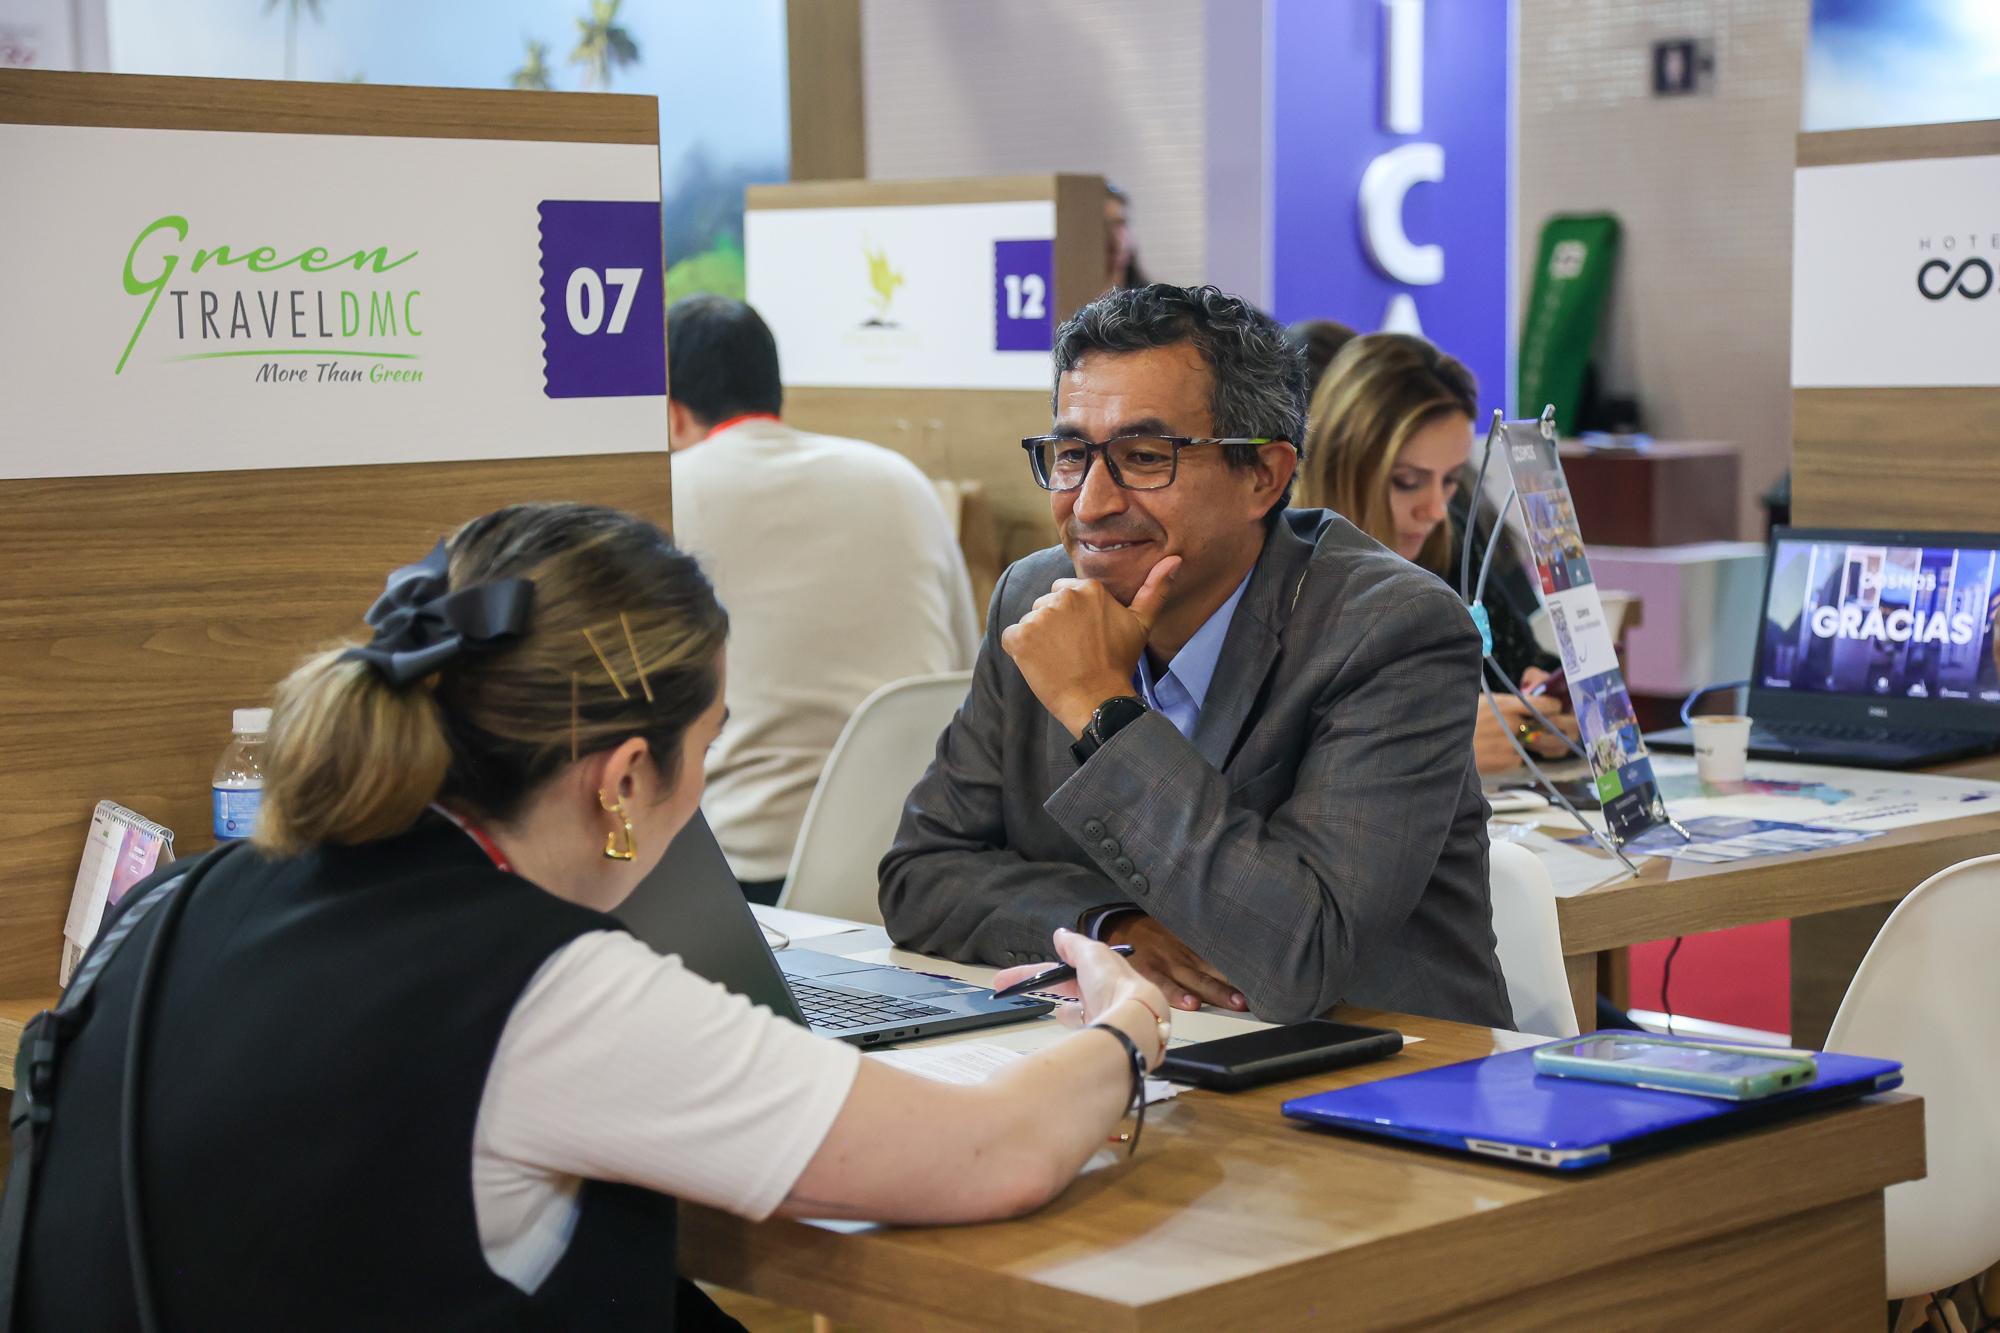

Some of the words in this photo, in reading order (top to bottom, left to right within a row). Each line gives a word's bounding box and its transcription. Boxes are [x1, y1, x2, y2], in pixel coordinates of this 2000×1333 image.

[114, 214, 419, 375] Green
[565, 266, 644, 336] 07
[1003, 273, 1047, 320] 12
[1917, 257, 2000, 301] CO
[255, 362, 308, 384] More
[316, 361, 363, 384] Than
[369, 363, 423, 384] Green
[1811, 605, 1974, 645] GRACIAS
[1026, 991, 1081, 1002] COLO
